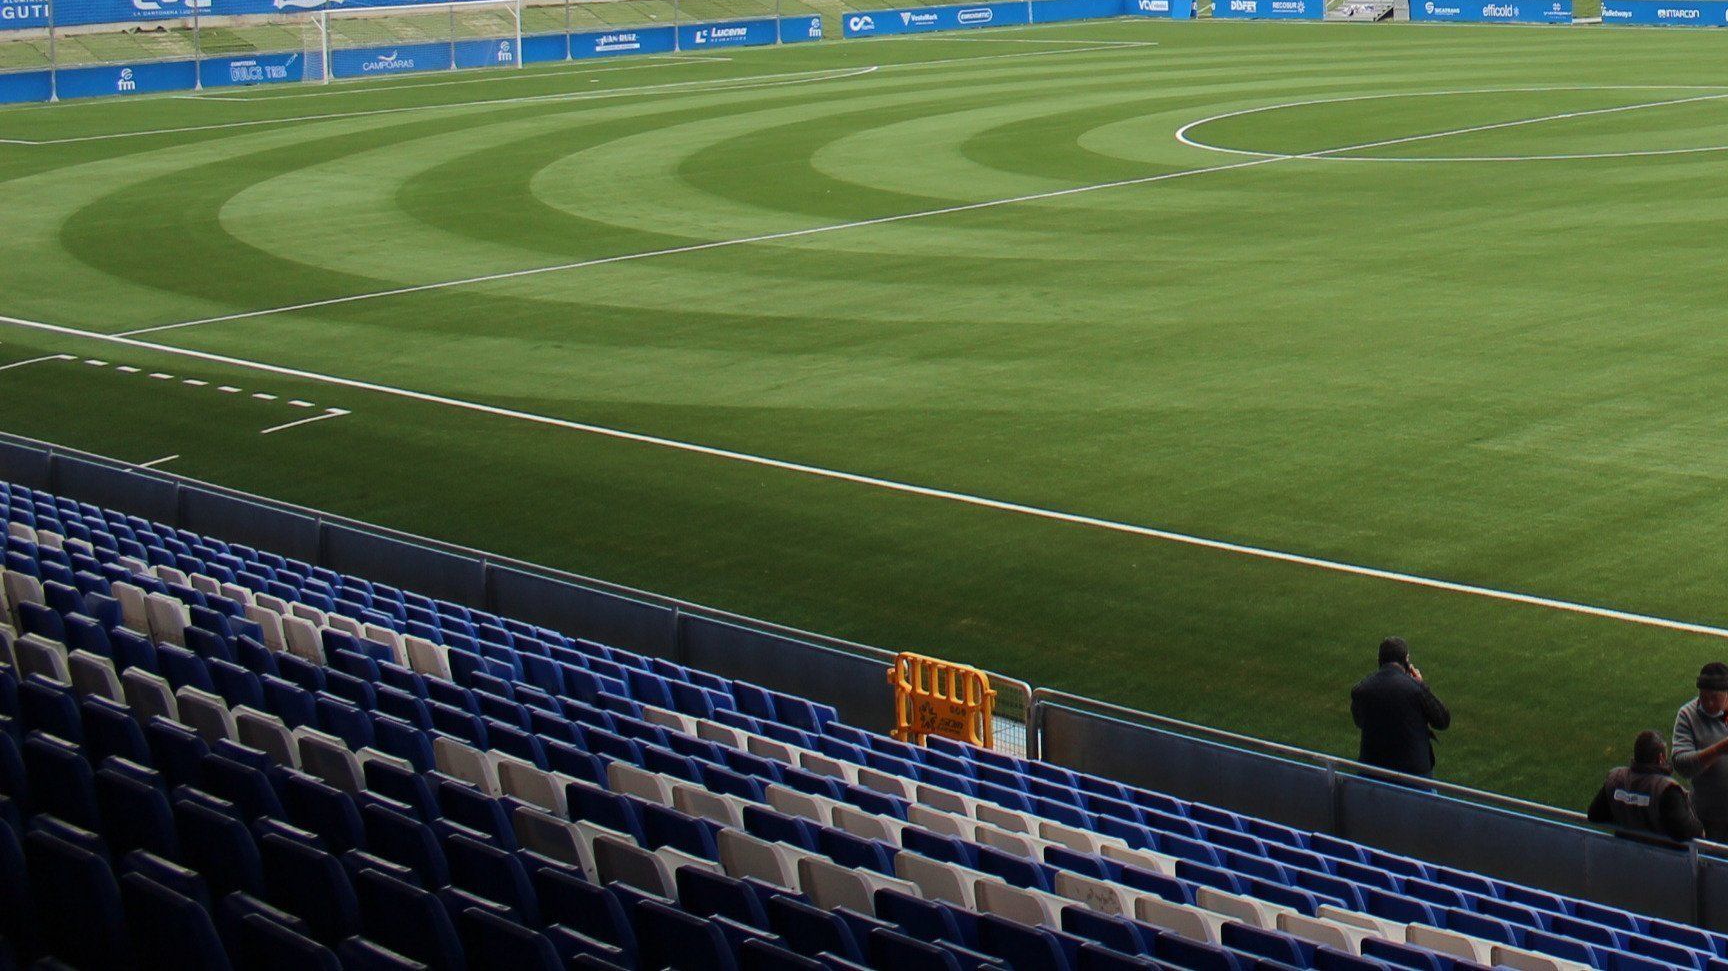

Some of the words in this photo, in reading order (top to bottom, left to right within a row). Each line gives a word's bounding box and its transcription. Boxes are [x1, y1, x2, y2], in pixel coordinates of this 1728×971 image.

[2, 4, 49, 19] GUTI
[1483, 4, 1513, 17] efficold
[711, 27, 747, 37] Lucena
[809, 26, 822, 38] fm
[498, 51, 512, 61] fm
[363, 59, 414, 71] CAMPOARAS
[118, 78, 135, 91] fm
